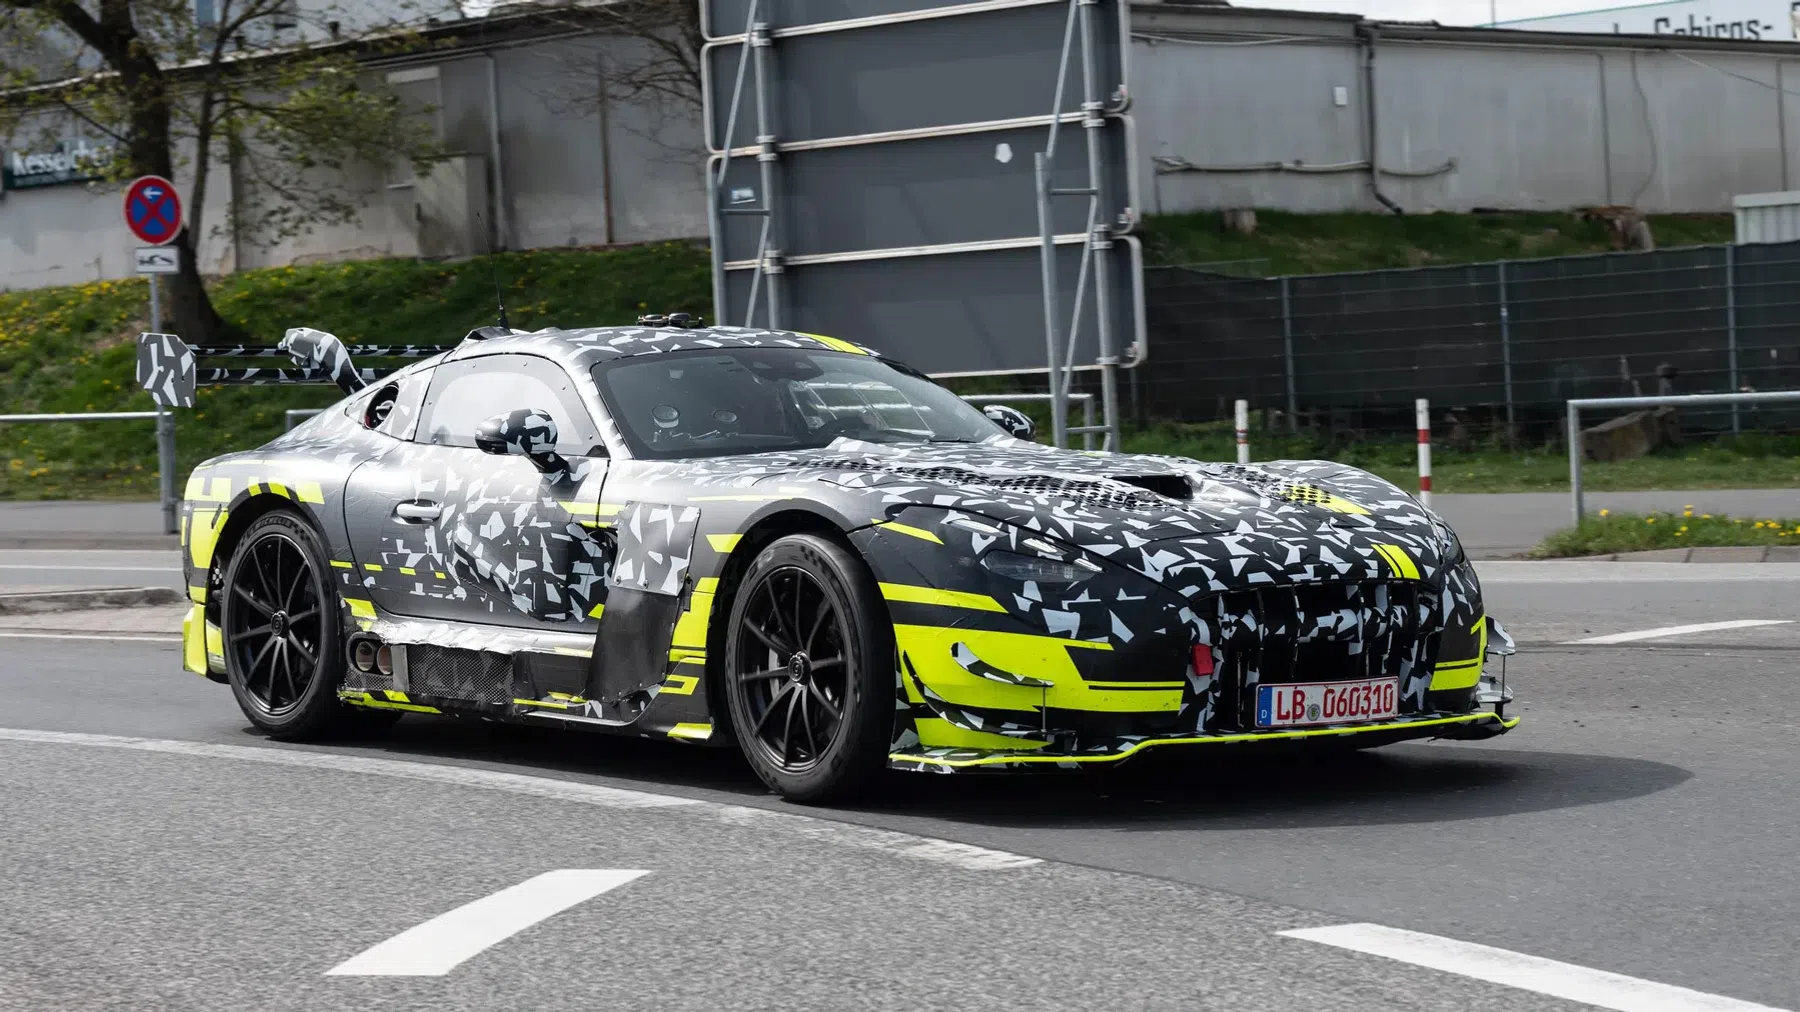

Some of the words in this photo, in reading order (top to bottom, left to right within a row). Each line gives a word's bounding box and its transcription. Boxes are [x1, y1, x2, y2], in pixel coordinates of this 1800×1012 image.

[1277, 689, 1306, 720] LB
[1322, 683, 1394, 718] 060310
[1261, 709, 1268, 719] D
